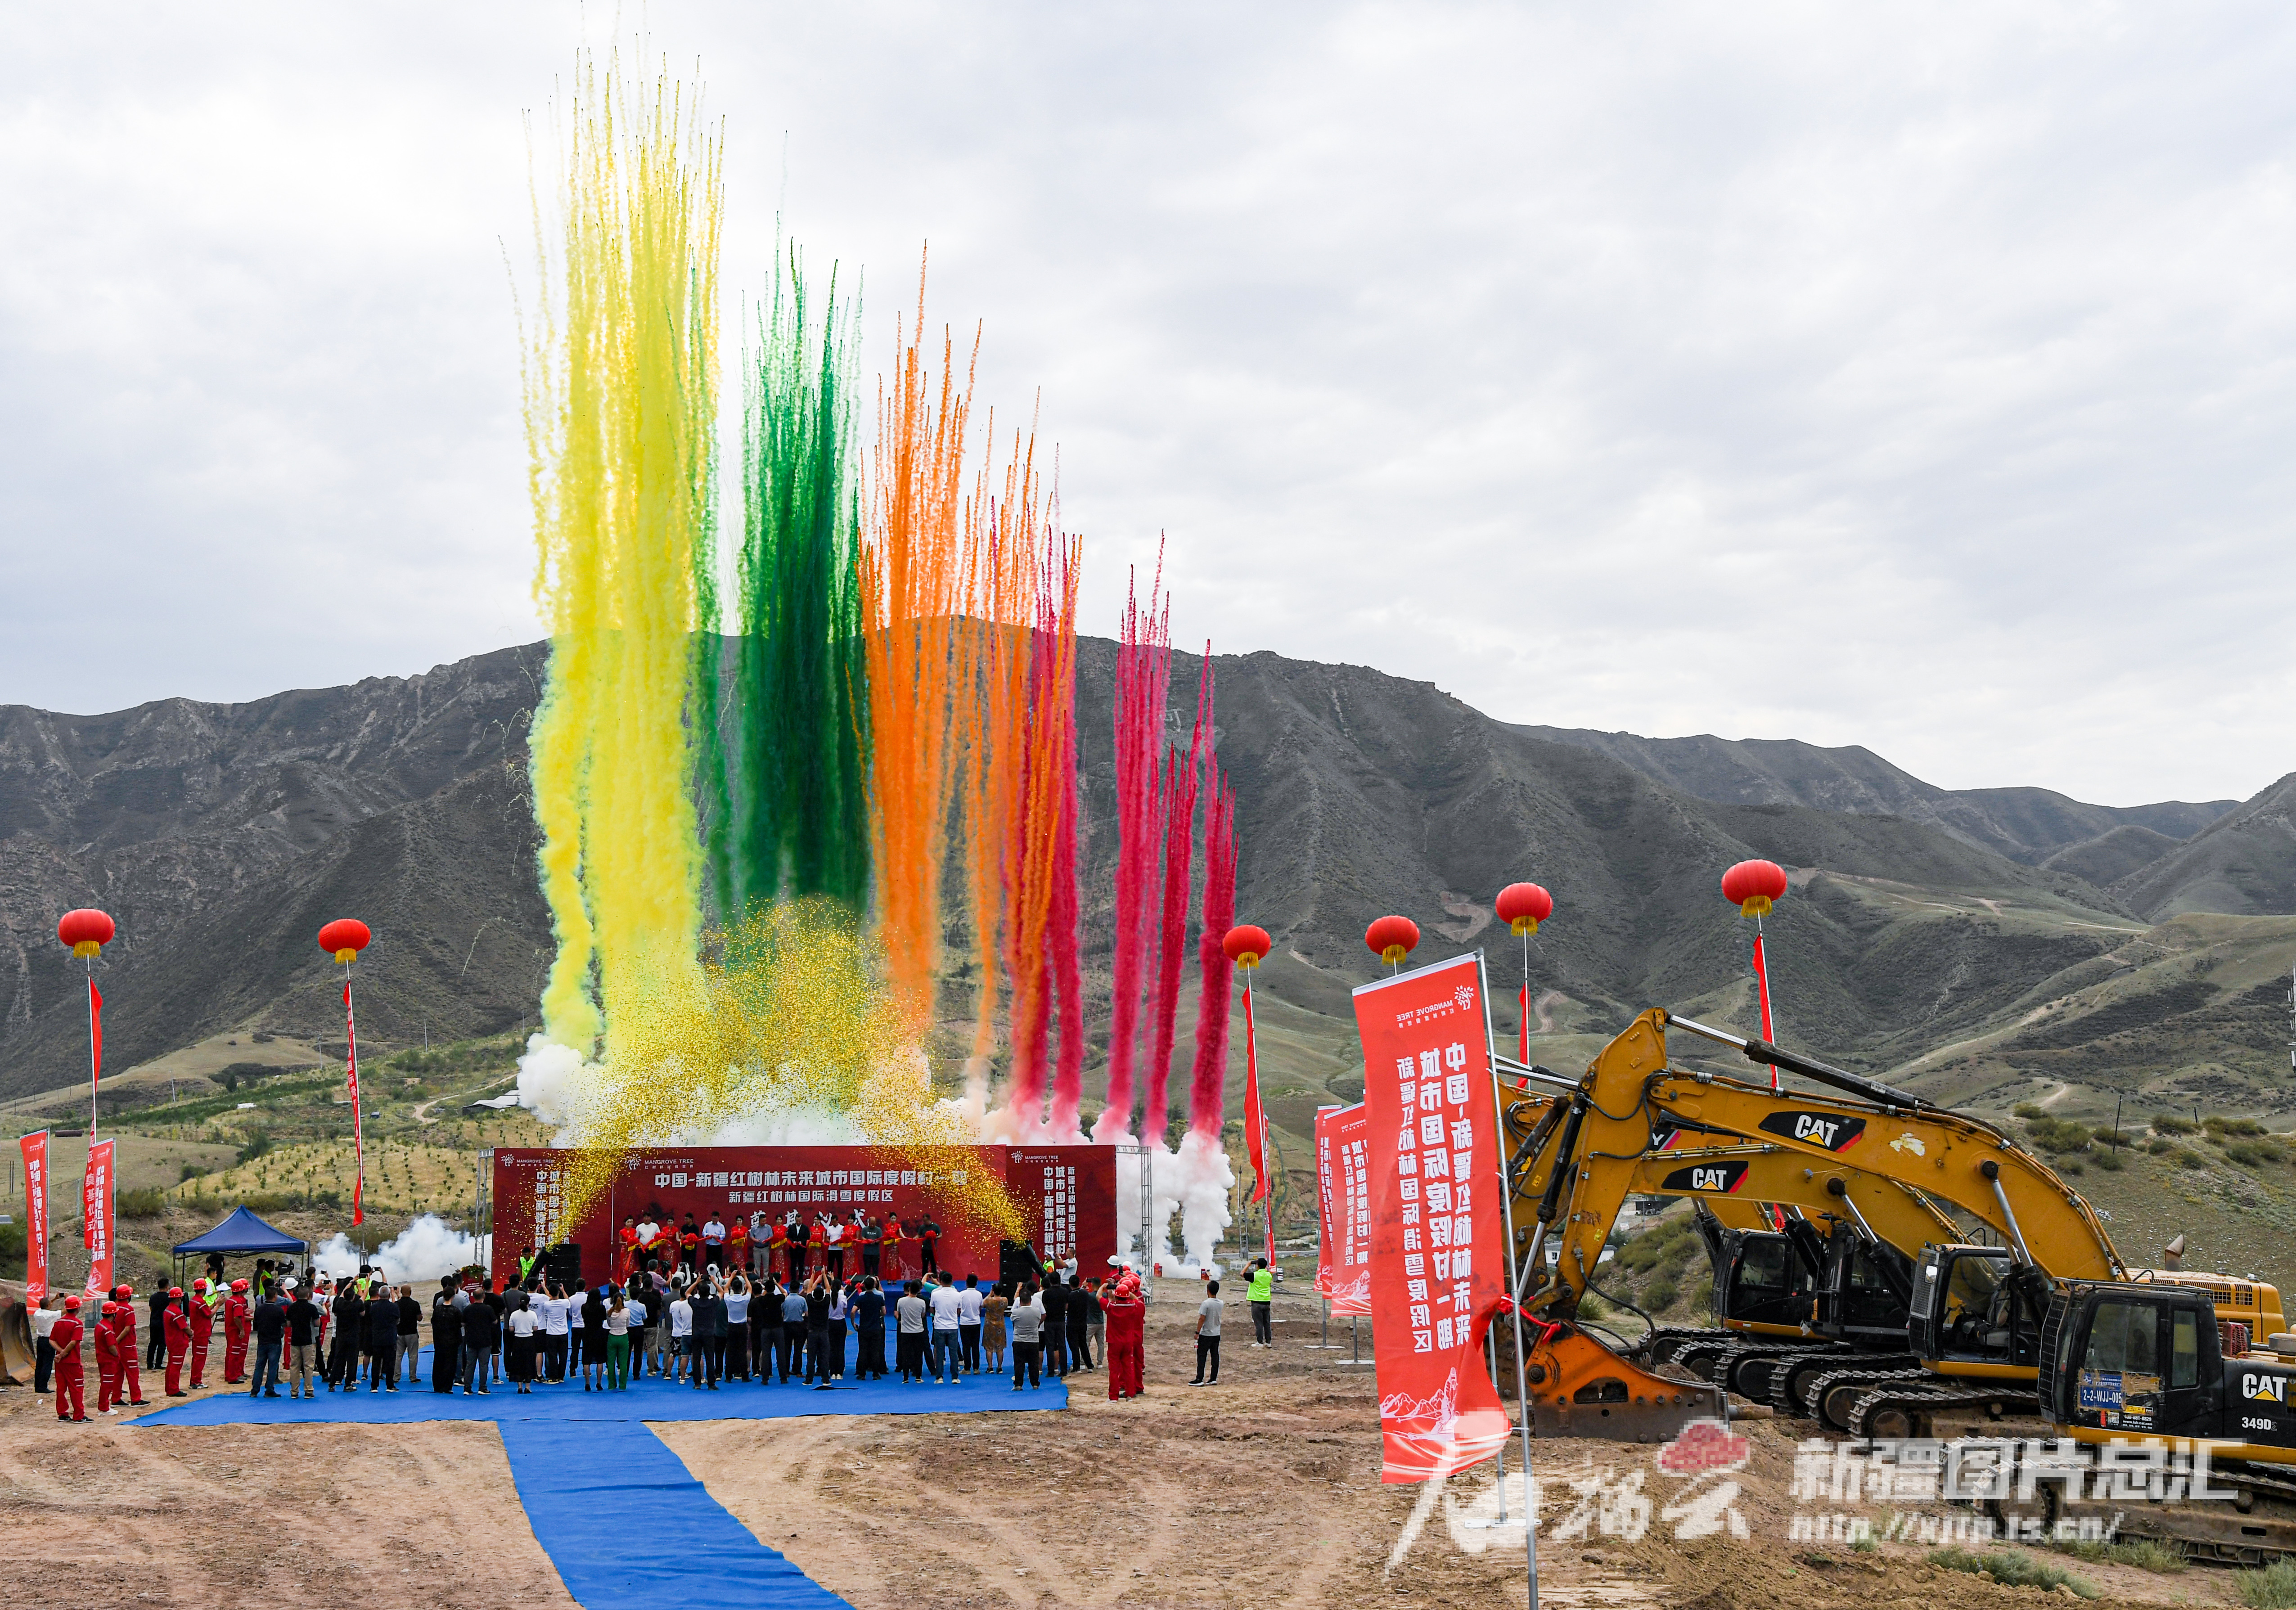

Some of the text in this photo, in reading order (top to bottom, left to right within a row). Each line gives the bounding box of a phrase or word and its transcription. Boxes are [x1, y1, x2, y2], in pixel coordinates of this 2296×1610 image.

[1794, 1115, 1839, 1147] CAT
[1692, 1168, 1727, 1191] CAT
[729, 1189, 893, 1204] 新疆红树林国际滑雪度假区
[2083, 1389, 2122, 1404] 2-2-WJJ-005
[2242, 1373, 2287, 1402] CAT
